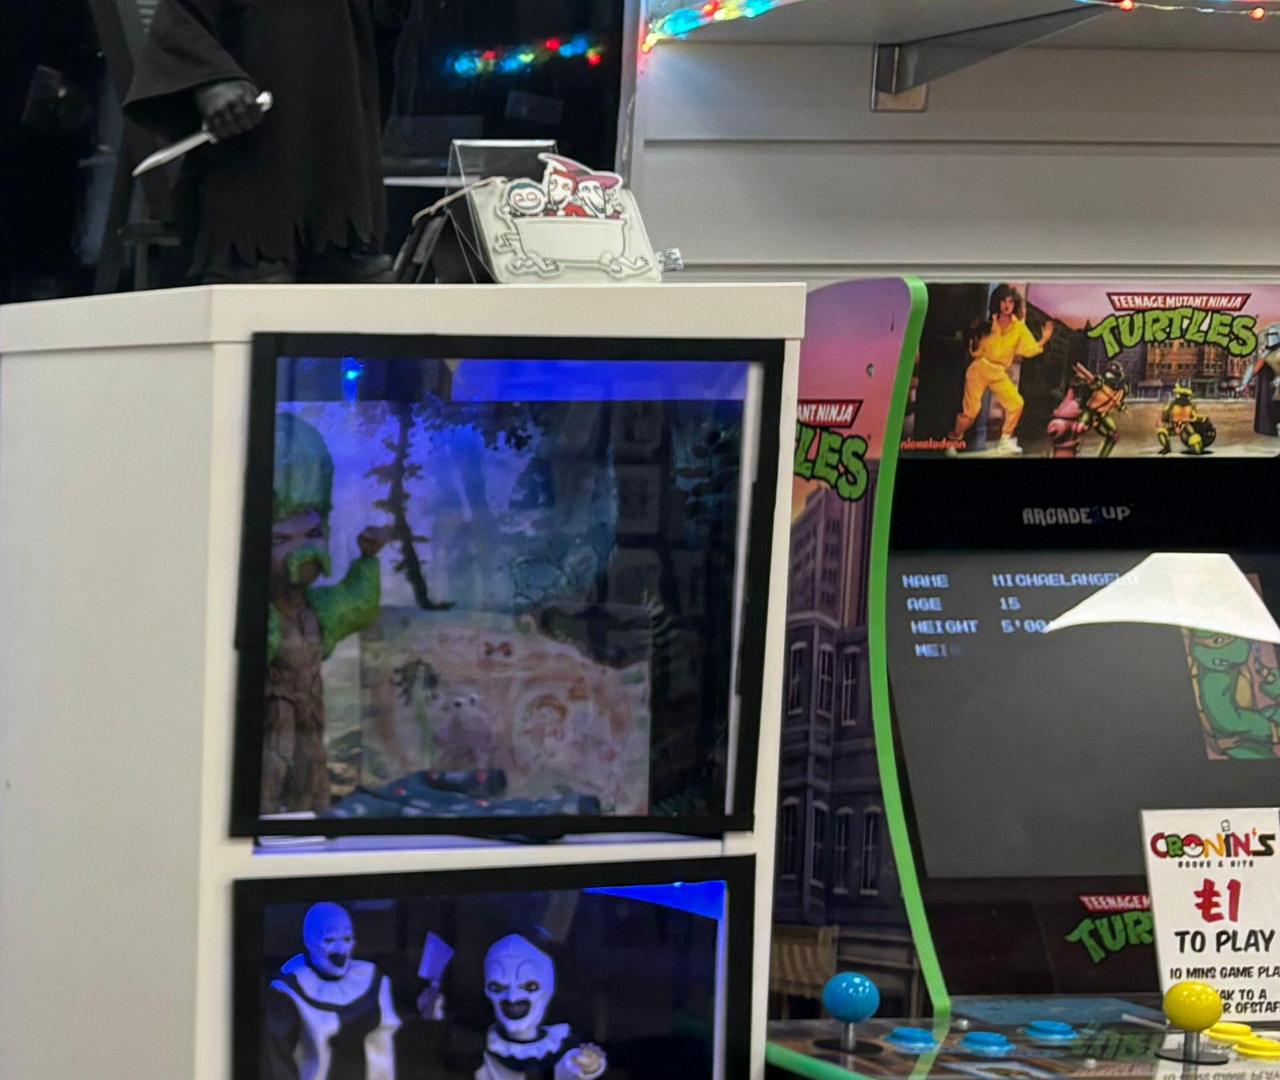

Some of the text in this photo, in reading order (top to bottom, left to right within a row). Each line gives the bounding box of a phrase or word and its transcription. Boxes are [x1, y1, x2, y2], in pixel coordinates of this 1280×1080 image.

[1111, 295, 1242, 307] TEENAGE MUTANT NINJA
[1087, 308, 1257, 358] TURTLES
[816, 403, 854, 422] NINJA
[1022, 507, 1092, 526] ARCADE
[902, 574, 949, 588] NAME
[907, 597, 1021, 611] AGE 15
[911, 619, 978, 634] HEIGHT
[1150, 826, 1276, 859] CRONIN'S
[1175, 930, 1275, 953] TO PLAY
[1169, 968, 1182, 979] 10
[1186, 967, 1217, 979] MINS
[1220, 966, 1254, 979] GAME
[1239, 989, 1255, 1000] TO
